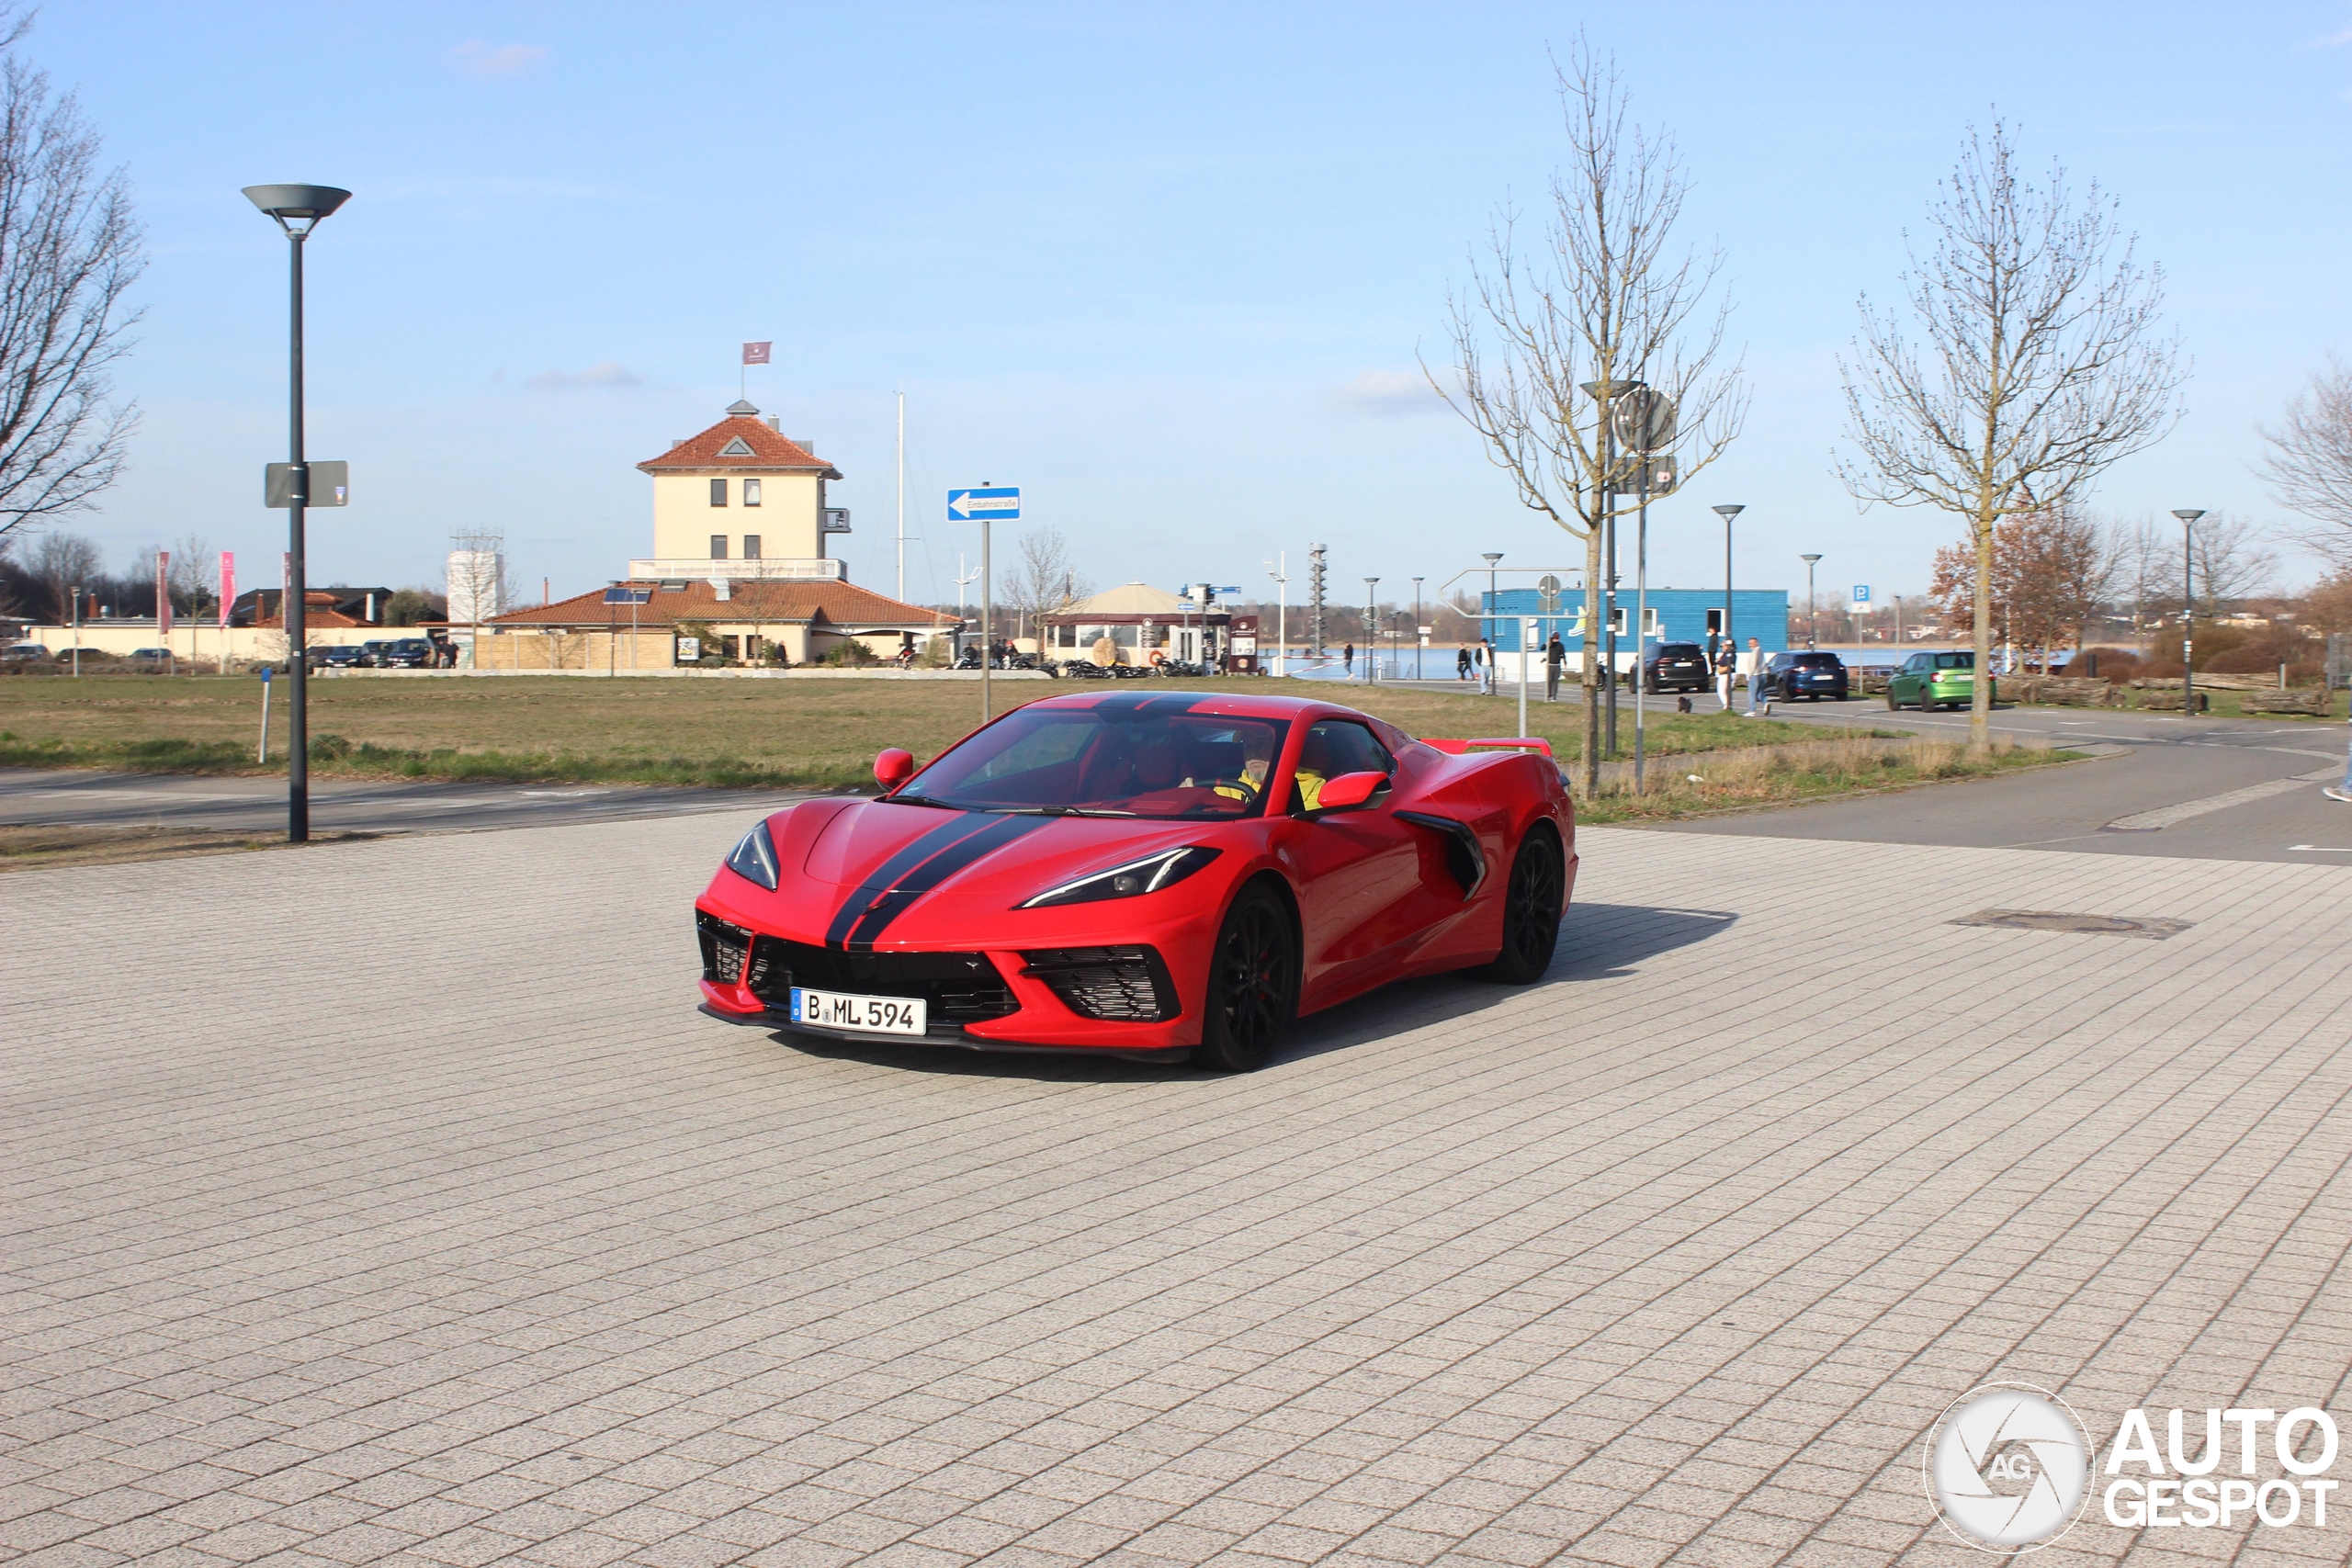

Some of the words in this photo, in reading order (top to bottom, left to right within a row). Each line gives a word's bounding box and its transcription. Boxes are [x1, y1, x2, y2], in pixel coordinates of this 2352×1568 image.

[967, 500, 1016, 508] Einbahnstraße
[794, 1008, 799, 1016] D
[808, 995, 820, 1019] B
[834, 998, 861, 1024] ML
[868, 1001, 913, 1029] 594
